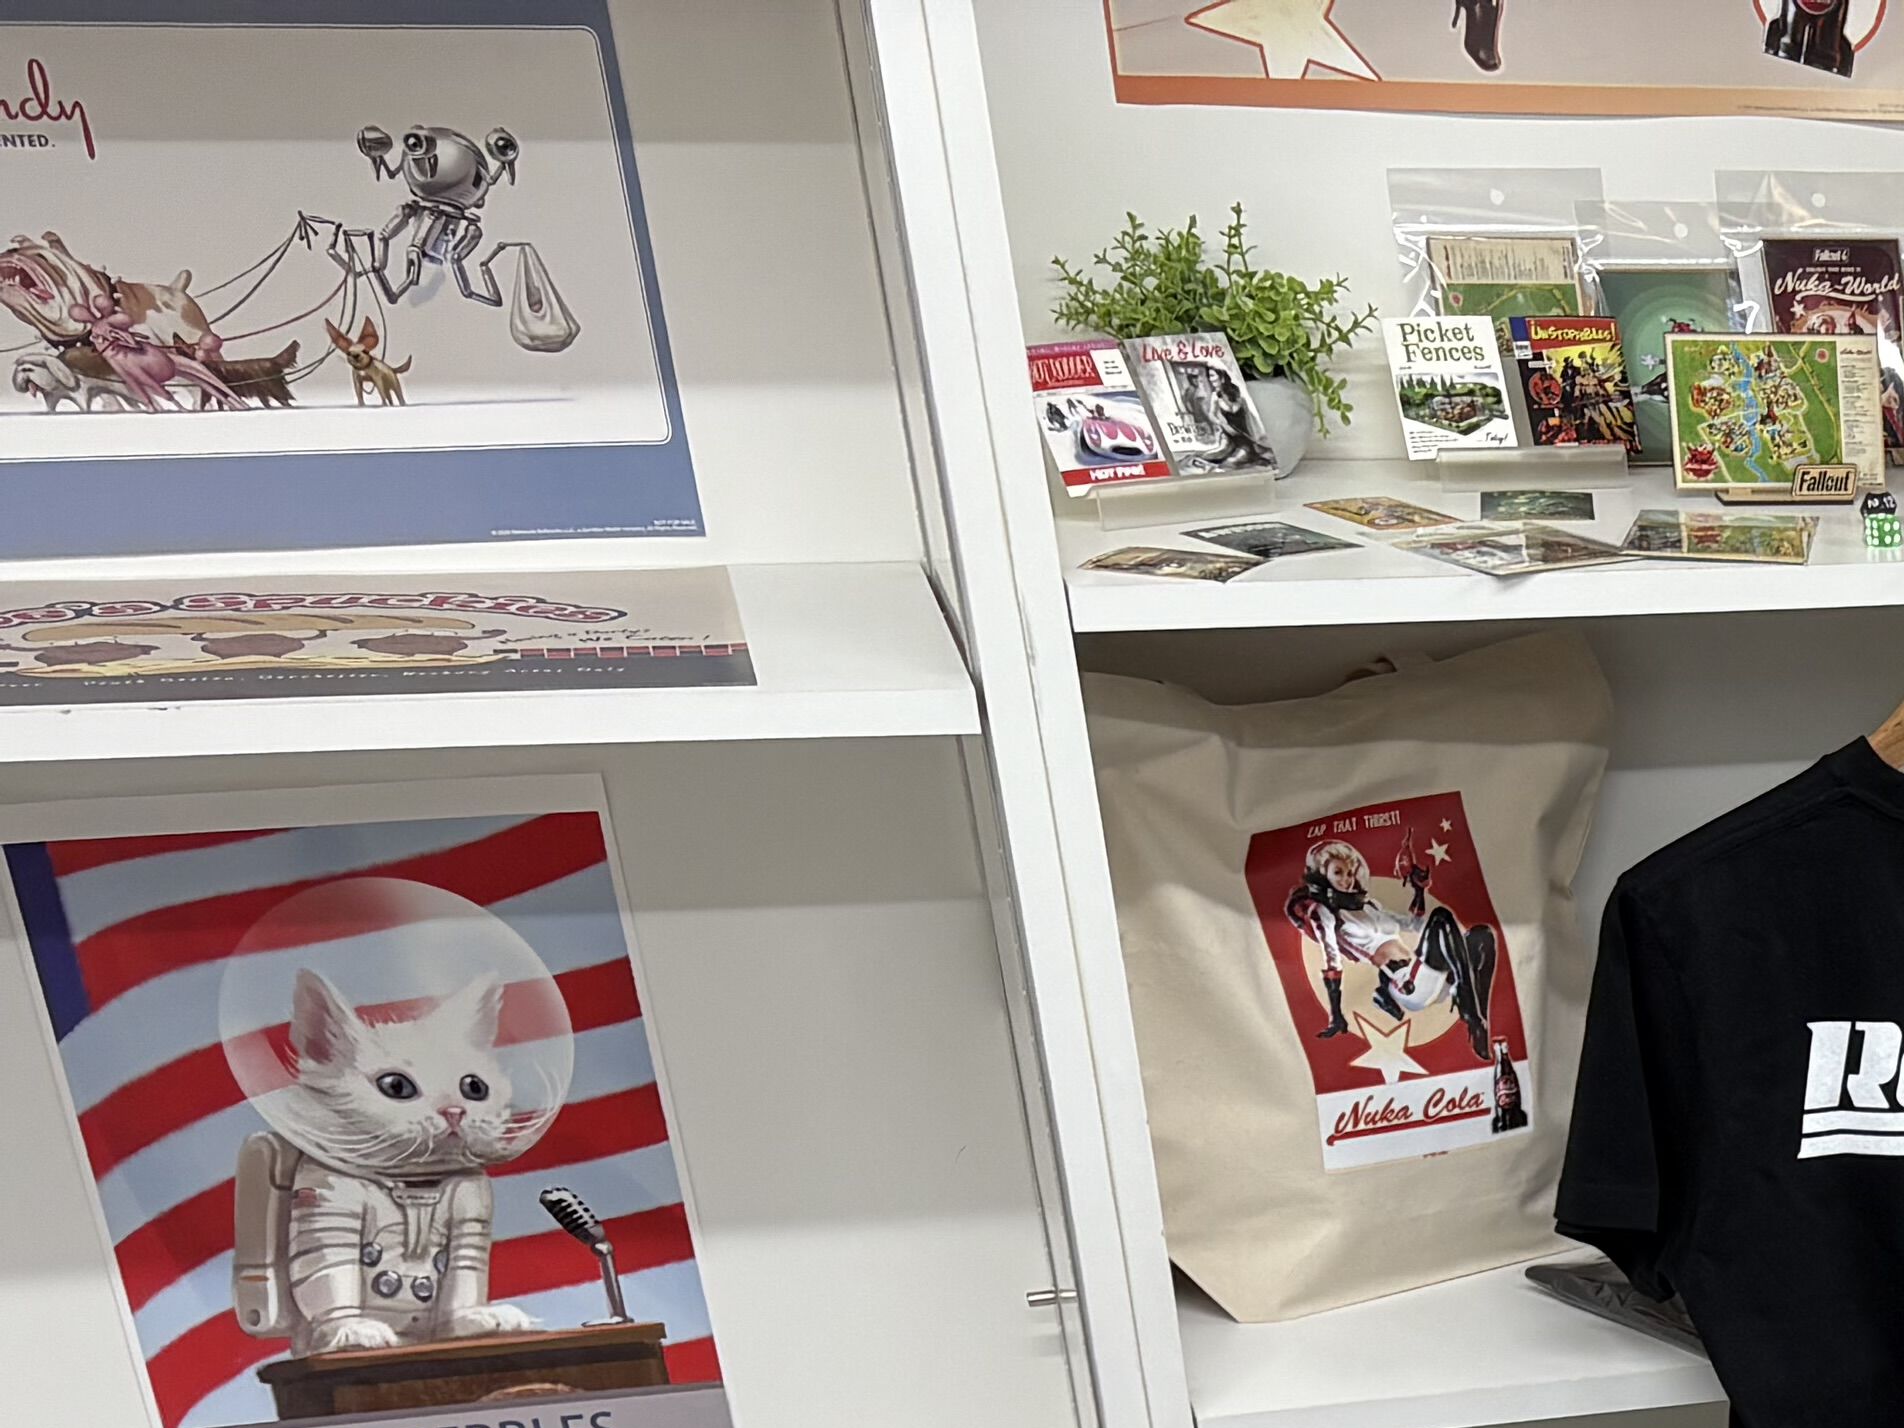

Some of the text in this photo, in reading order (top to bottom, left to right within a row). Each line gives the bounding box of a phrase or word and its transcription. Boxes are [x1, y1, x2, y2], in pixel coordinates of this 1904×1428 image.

[1400, 321, 1475, 343] Picket
[1177, 340, 1190, 361] &
[1191, 340, 1225, 359] Love
[1405, 343, 1486, 363] Fences
[1798, 471, 1851, 492] Fallout
[1333, 1086, 1485, 1136] Nuka Cola
